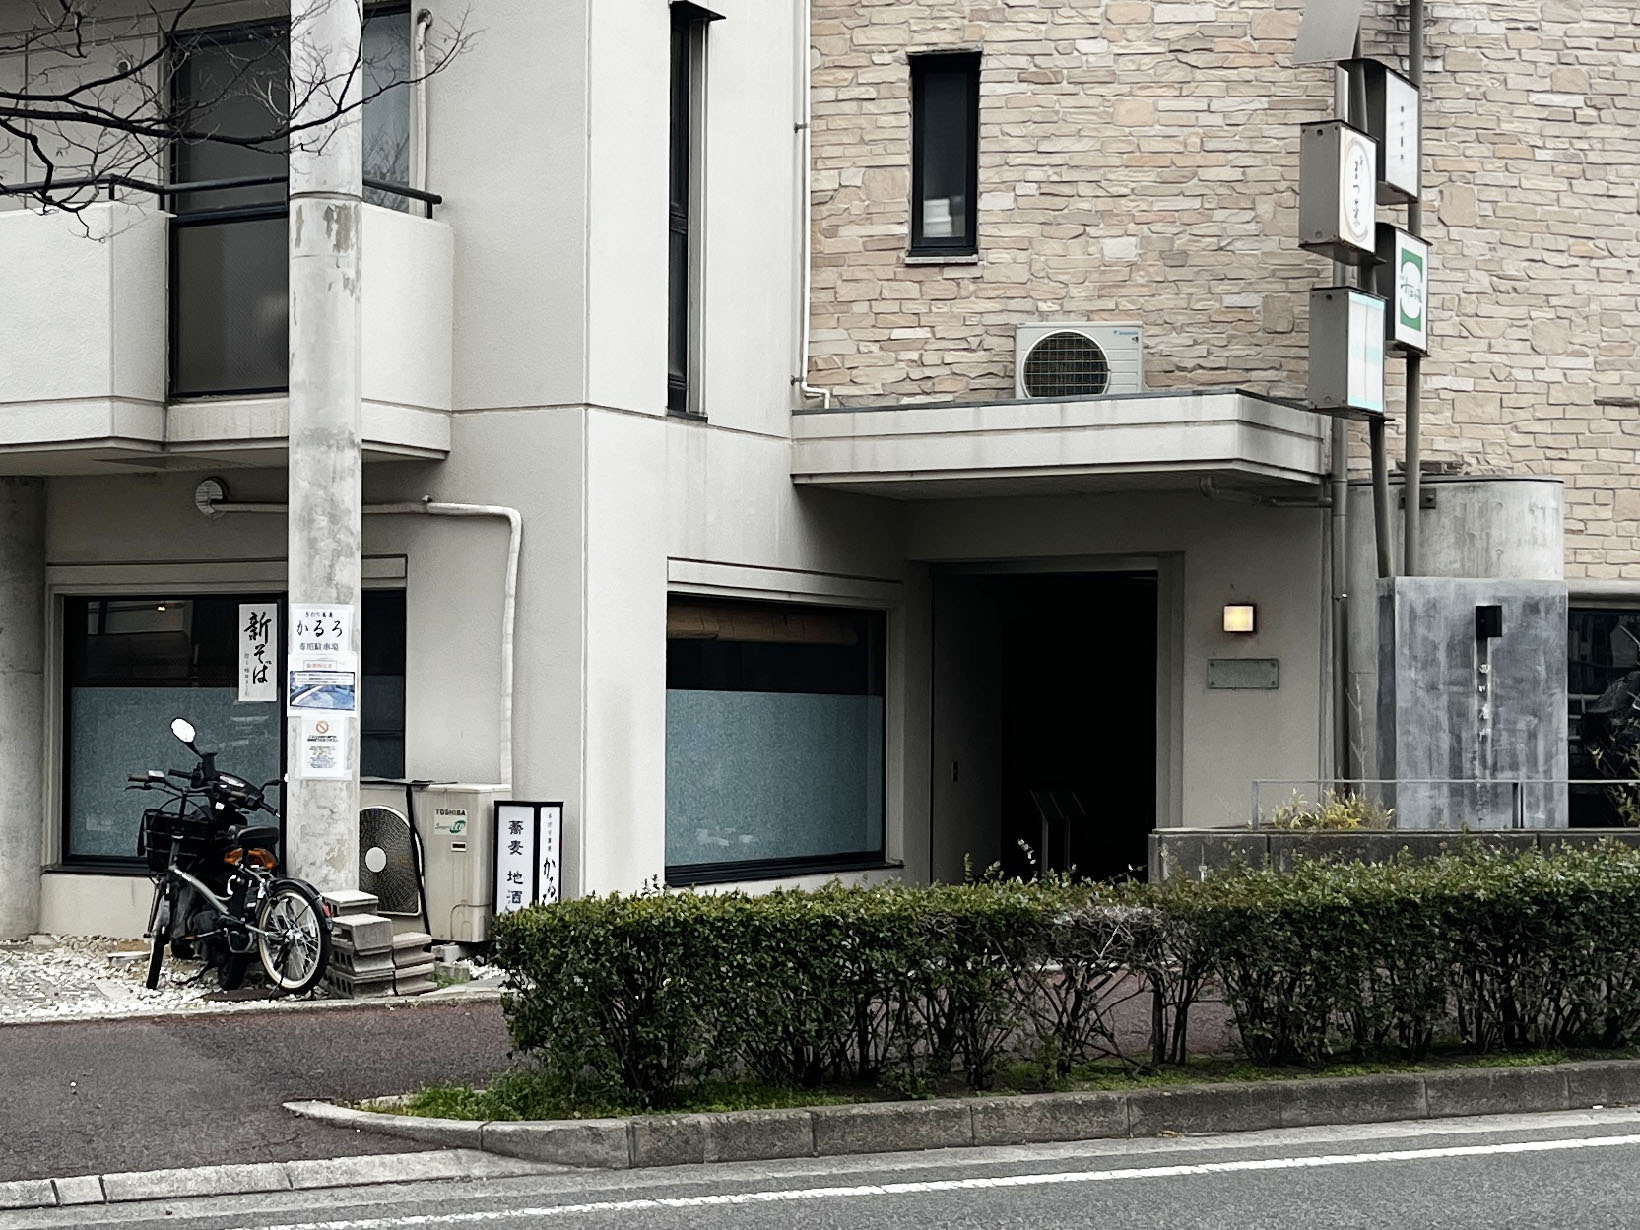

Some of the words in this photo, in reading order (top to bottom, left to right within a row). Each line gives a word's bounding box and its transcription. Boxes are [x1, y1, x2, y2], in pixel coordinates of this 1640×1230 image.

[296, 619, 343, 638] かるろ
[243, 611, 272, 685] 新そば
[435, 808, 466, 816] TOSHIBA
[507, 820, 524, 856] 蕎麦
